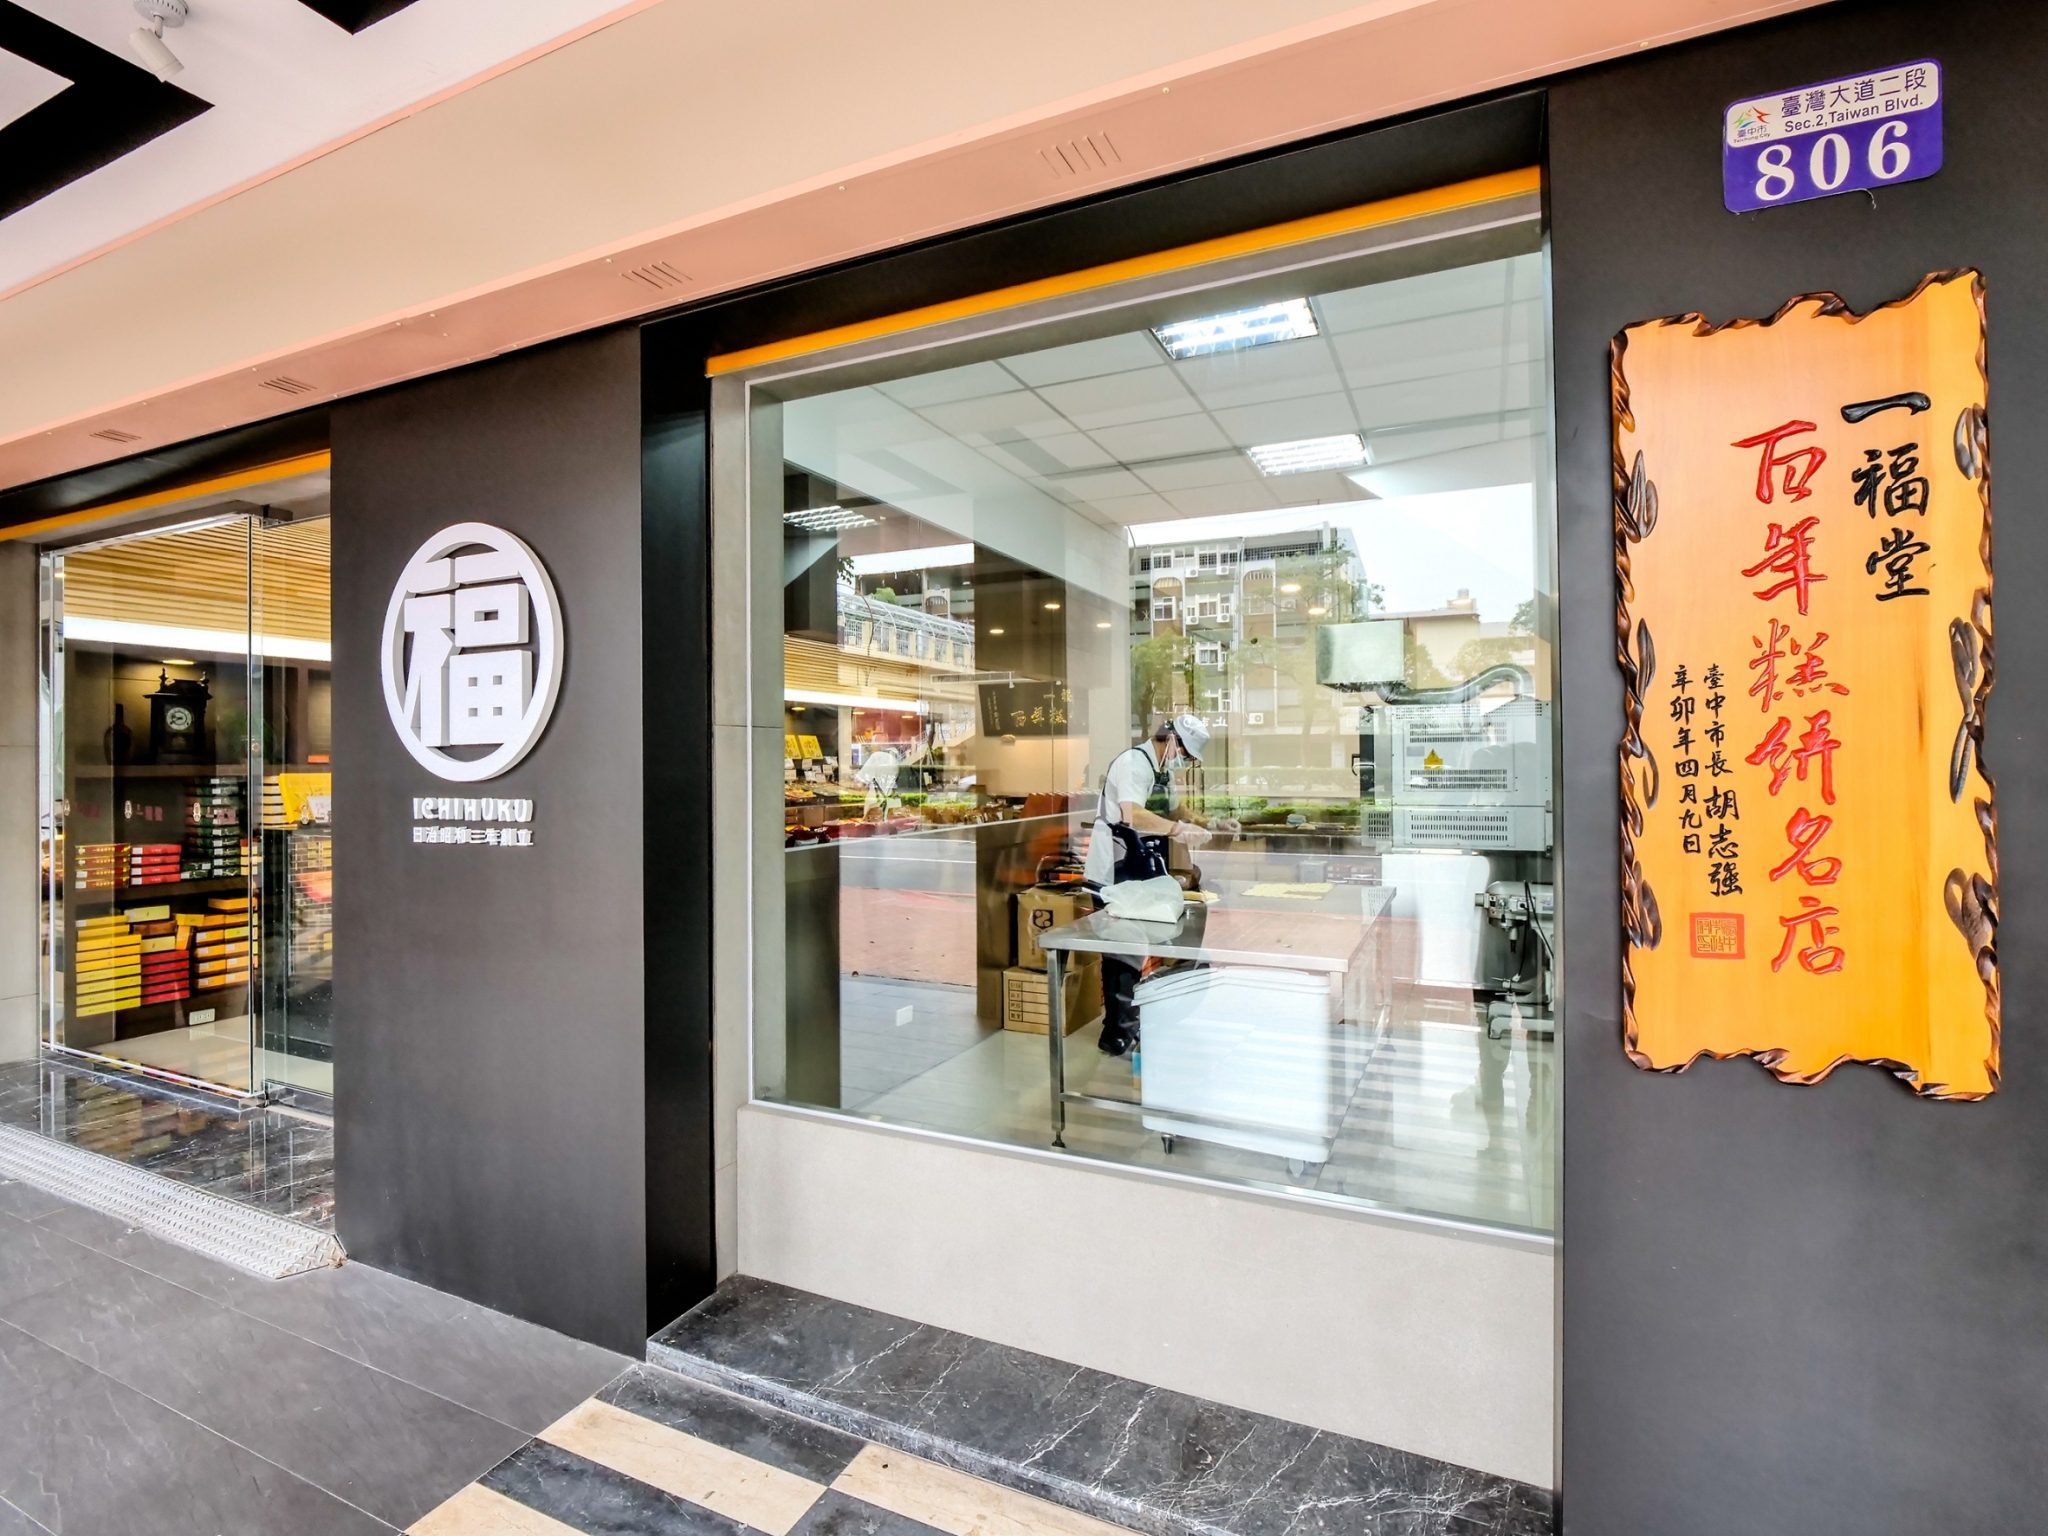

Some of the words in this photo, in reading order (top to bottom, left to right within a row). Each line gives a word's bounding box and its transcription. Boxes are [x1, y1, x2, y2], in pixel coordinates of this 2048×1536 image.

[1781, 67, 1927, 118] 臺灣大道二段
[1884, 94, 1924, 112] Blvd.
[1755, 120, 1911, 201] 806
[1840, 391, 1932, 602] 一福堂
[1730, 419, 1850, 975] 百年糕餅名店
[1669, 663, 1703, 855] 辛卯年四月九日
[413, 797, 533, 823] ICHIHUKU
